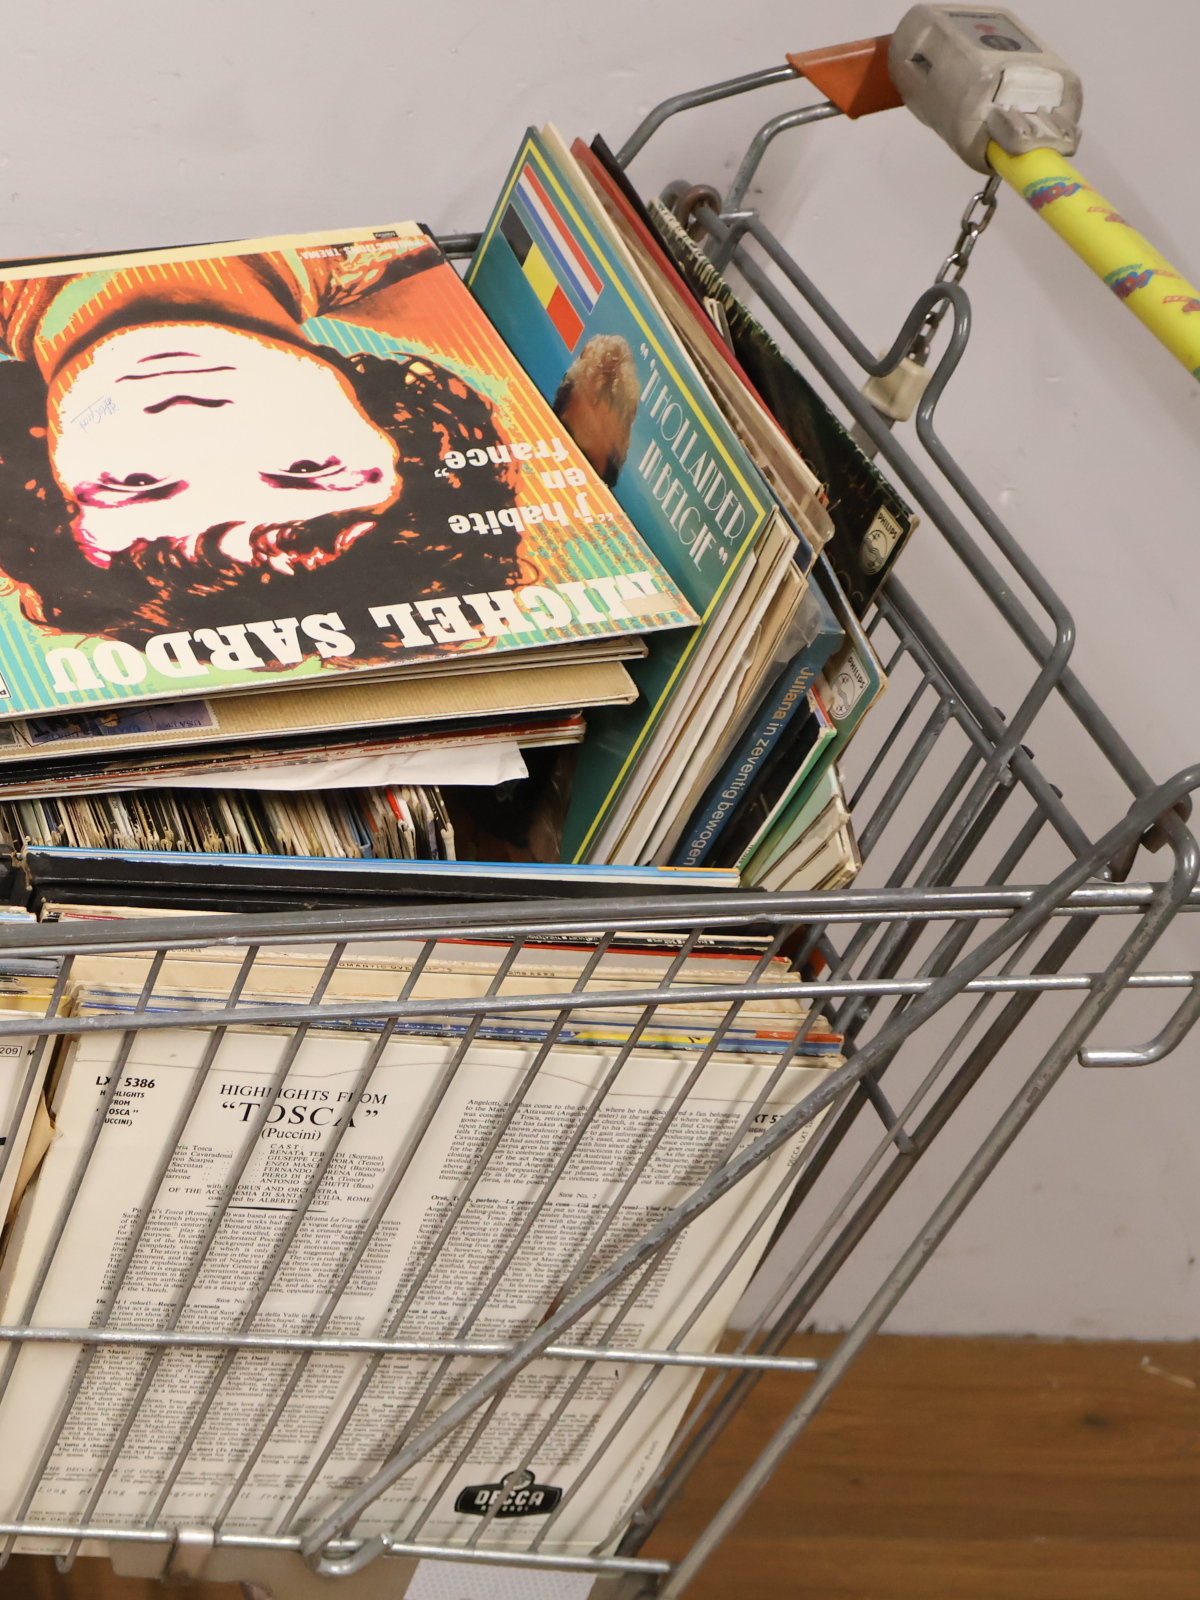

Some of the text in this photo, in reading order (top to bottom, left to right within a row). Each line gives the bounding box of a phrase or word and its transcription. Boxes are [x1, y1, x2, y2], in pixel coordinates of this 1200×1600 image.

[300, 247, 341, 260] TREMA
[638, 438, 664, 484] IN
[650, 385, 747, 546] HOLLANDER
[540, 467, 587, 489] en
[877, 512, 898, 540] PHILIPS
[45, 570, 660, 693] MICHEL SARDOU
[847, 655, 866, 690] PHILIPS
[772, 666, 815, 720] Juliana
[762, 723, 785, 736] in
[722, 737, 770, 800] zeventig
[683, 801, 735, 867] bewogen
[124, 1077, 156, 1089] 5386
[100, 1089, 146, 1099] HHLIGHTS
[219, 1084, 389, 1105] HIGHIGHTS FOM
[260, 1127, 322, 1142] (Puccini)
[190, 1149, 385, 1167] Cavaradossi GIUSEPPE CAPORA (Tenor)
[192, 1144, 384, 1162] Tosca RENATA (Soprano)
[187, 1156, 386, 1173] Scarpia ENZO MASCRINI (Baritone)
[263, 1166, 313, 1175] FERNANDO
[259, 1177, 300, 1186] ANTONIO
[302, 1179, 351, 1189] SACHETTI
[261, 1171, 288, 1180] PIERO
[304, 1173, 335, 1182] PAMA
[184, 1187, 373, 1203] THE SANTA ROME
[258, 1196, 299, 1205] ALBERTO
